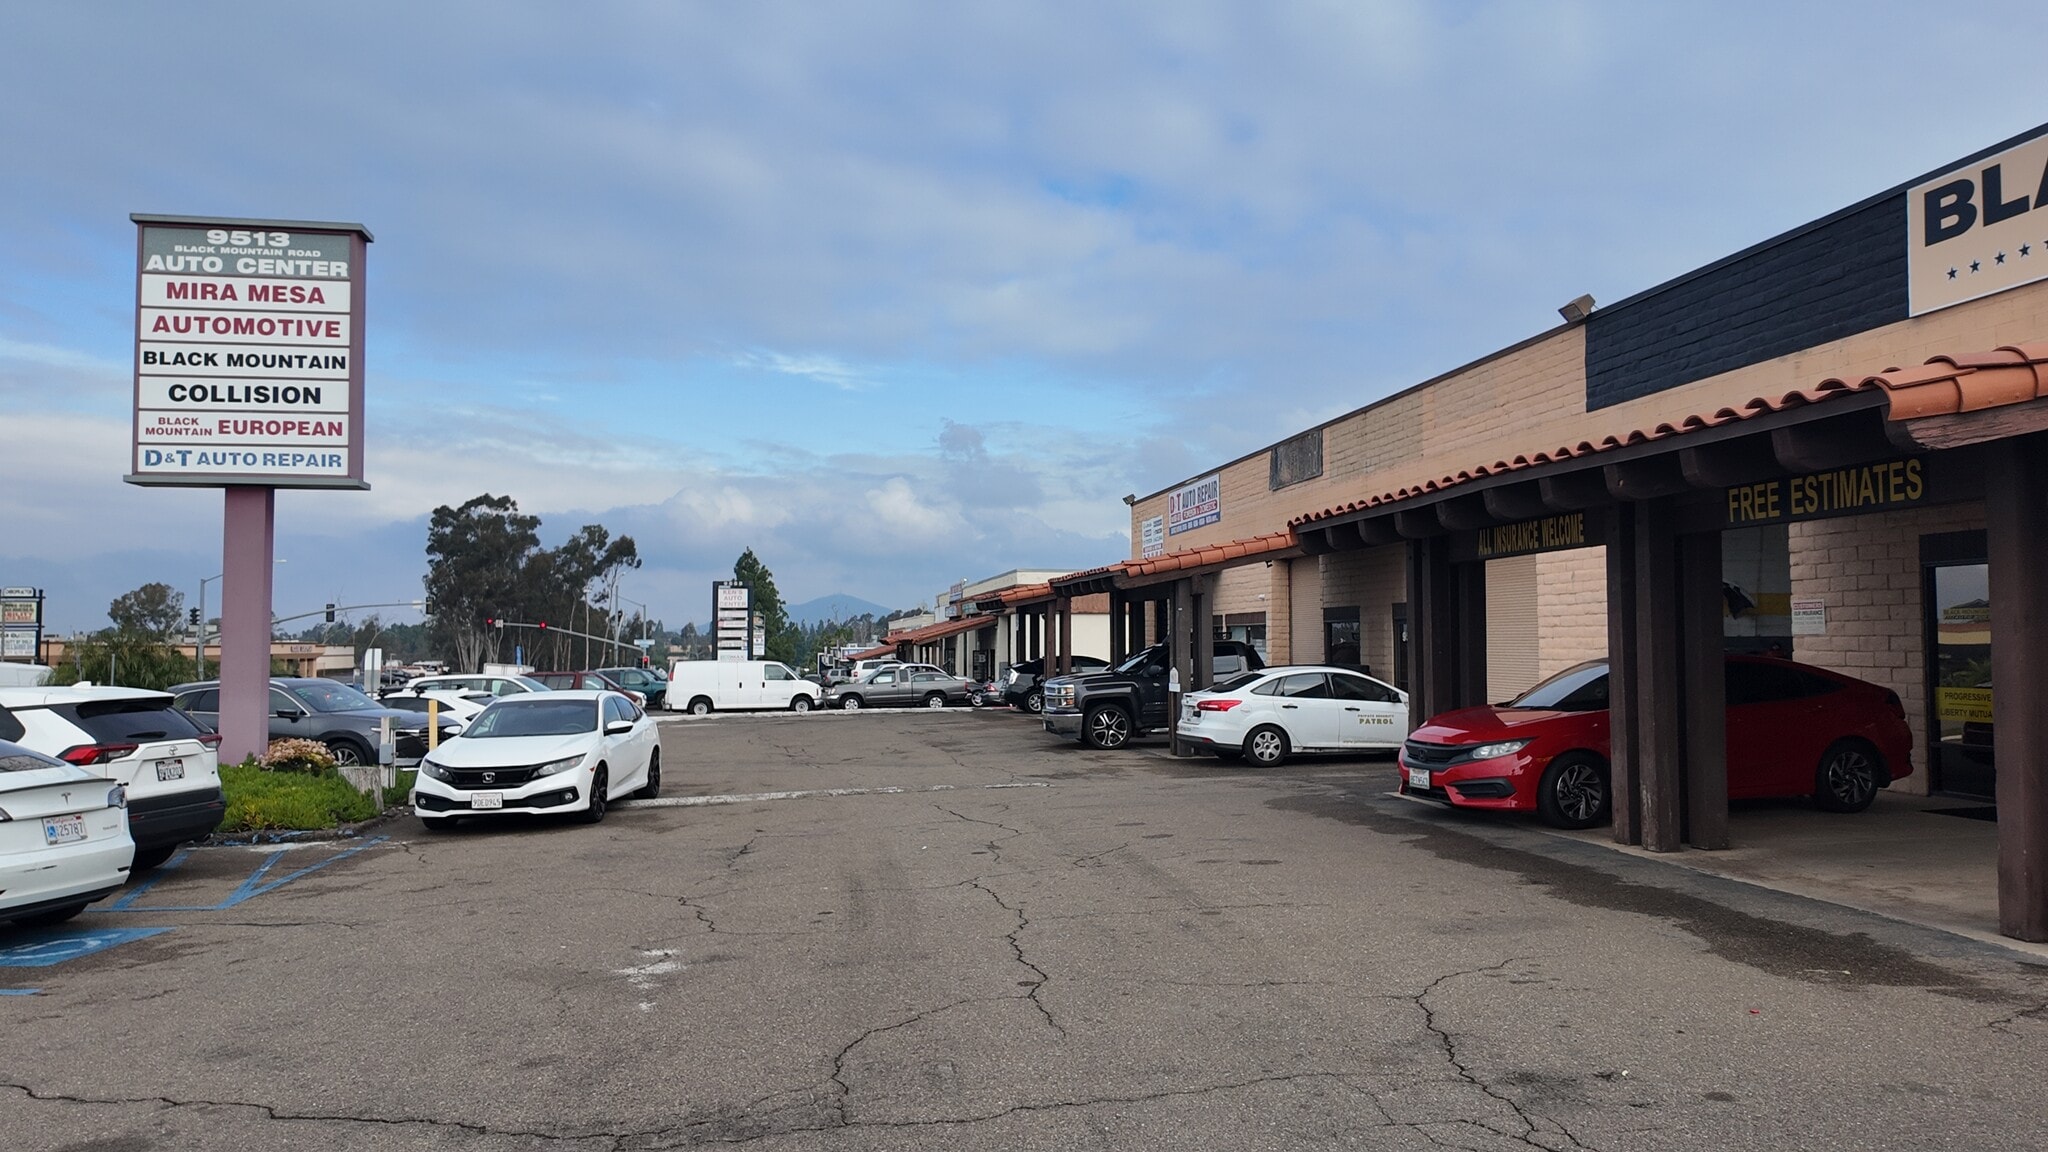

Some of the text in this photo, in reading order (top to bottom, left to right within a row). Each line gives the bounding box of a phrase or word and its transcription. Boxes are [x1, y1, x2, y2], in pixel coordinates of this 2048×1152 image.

[1924, 155, 2048, 247] BL
[206, 229, 290, 247] 9513
[174, 245, 321, 257] BLACK MOUNTAIN ROAD
[145, 255, 348, 277] AUTO CENTER
[166, 282, 325, 304] MIRA MESA
[152, 315, 341, 338] AUTOMOTIVE
[143, 351, 346, 370] BLACK MOUNTAIN
[168, 384, 321, 404] COLLISION
[158, 417, 199, 426] BLACK
[218, 420, 343, 436] EUROPEAN
[145, 427, 212, 436] MOUNTAIN
[145, 450, 342, 467] D&T AUTO REPAIR
[1182, 489, 1196, 509] AUTO
[1198, 481, 1218, 504] REPAIR
[1728, 458, 1923, 522] FREE ESTIMATES
[1479, 513, 1584, 556] ALL INSURANCE WELCOME
[1945, 692, 1991, 702] PROGRESSIVE
[1941, 708, 1968, 717] LIBERTY
